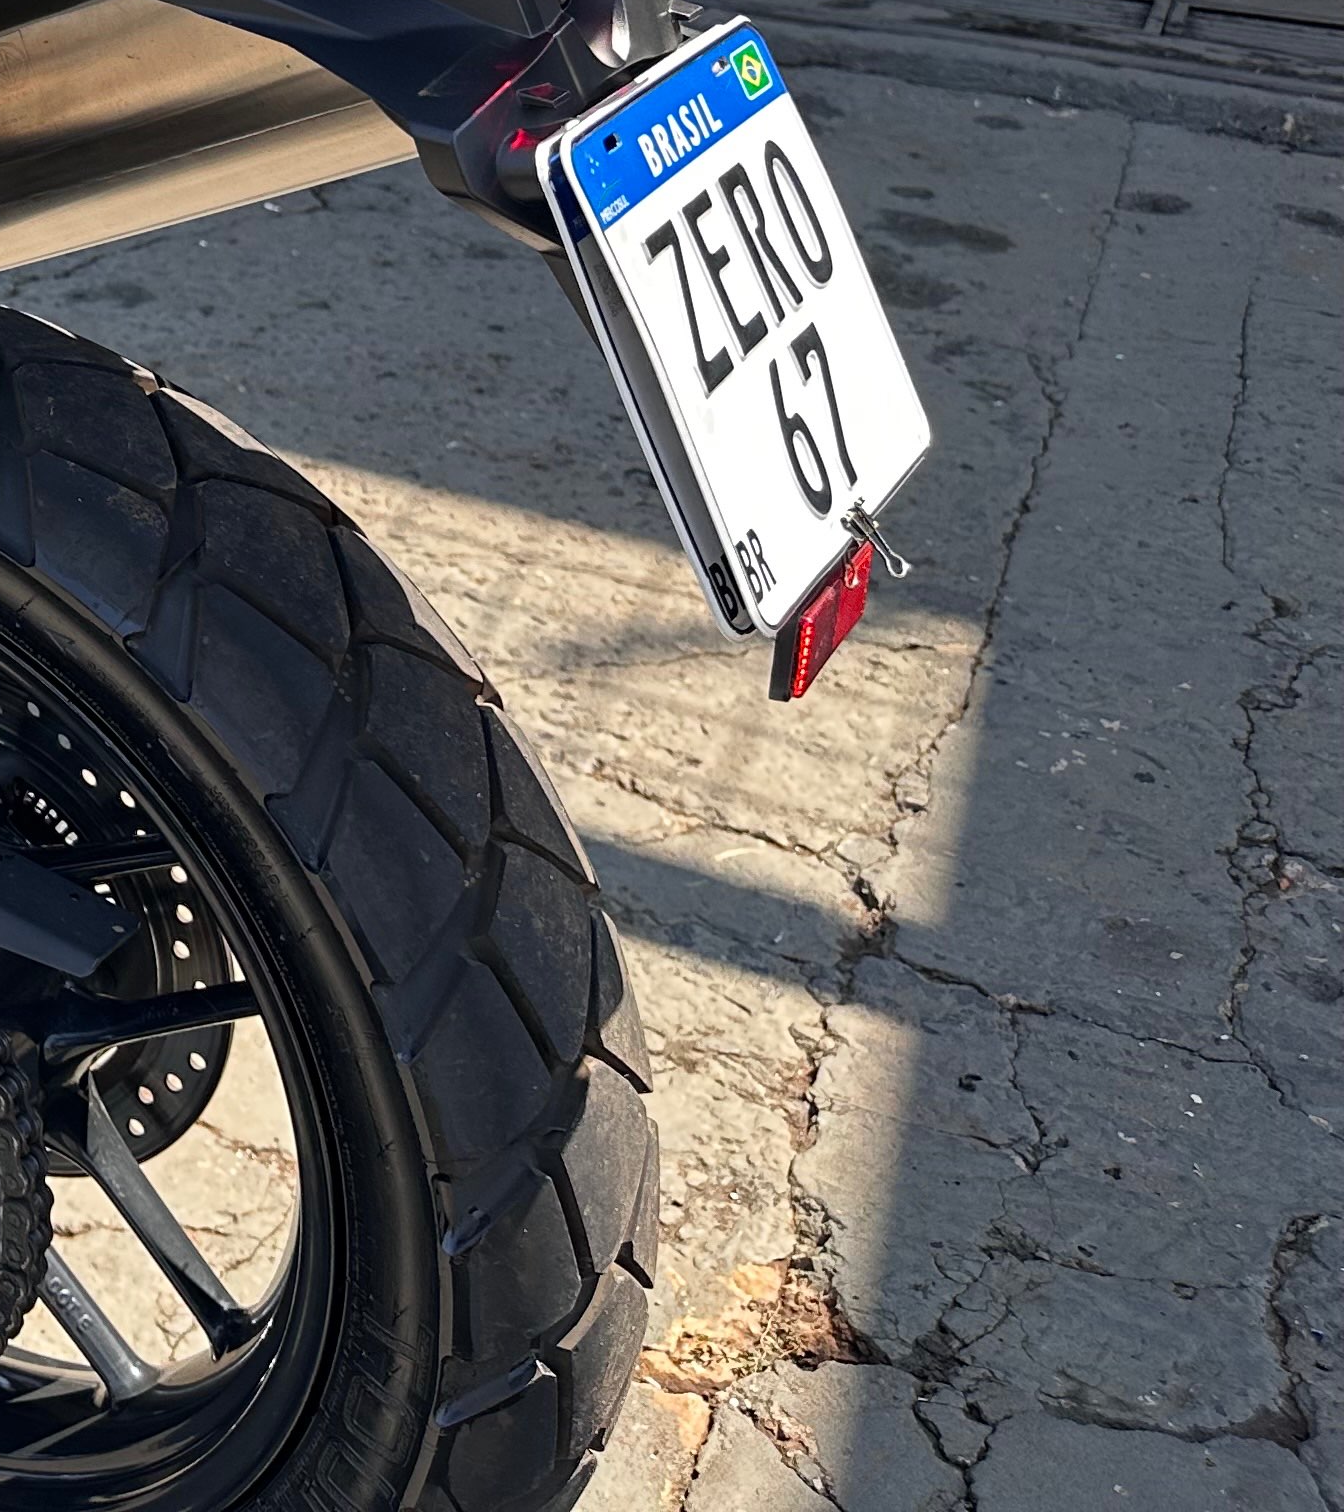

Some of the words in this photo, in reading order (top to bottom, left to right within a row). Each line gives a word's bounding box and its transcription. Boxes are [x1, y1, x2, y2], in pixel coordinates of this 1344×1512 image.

[636, 92, 724, 178] BRASIL
[644, 139, 834, 395] ZERO
[768, 322, 859, 517] 67
[708, 553, 746, 621] B
[734, 528, 777, 605] BR
